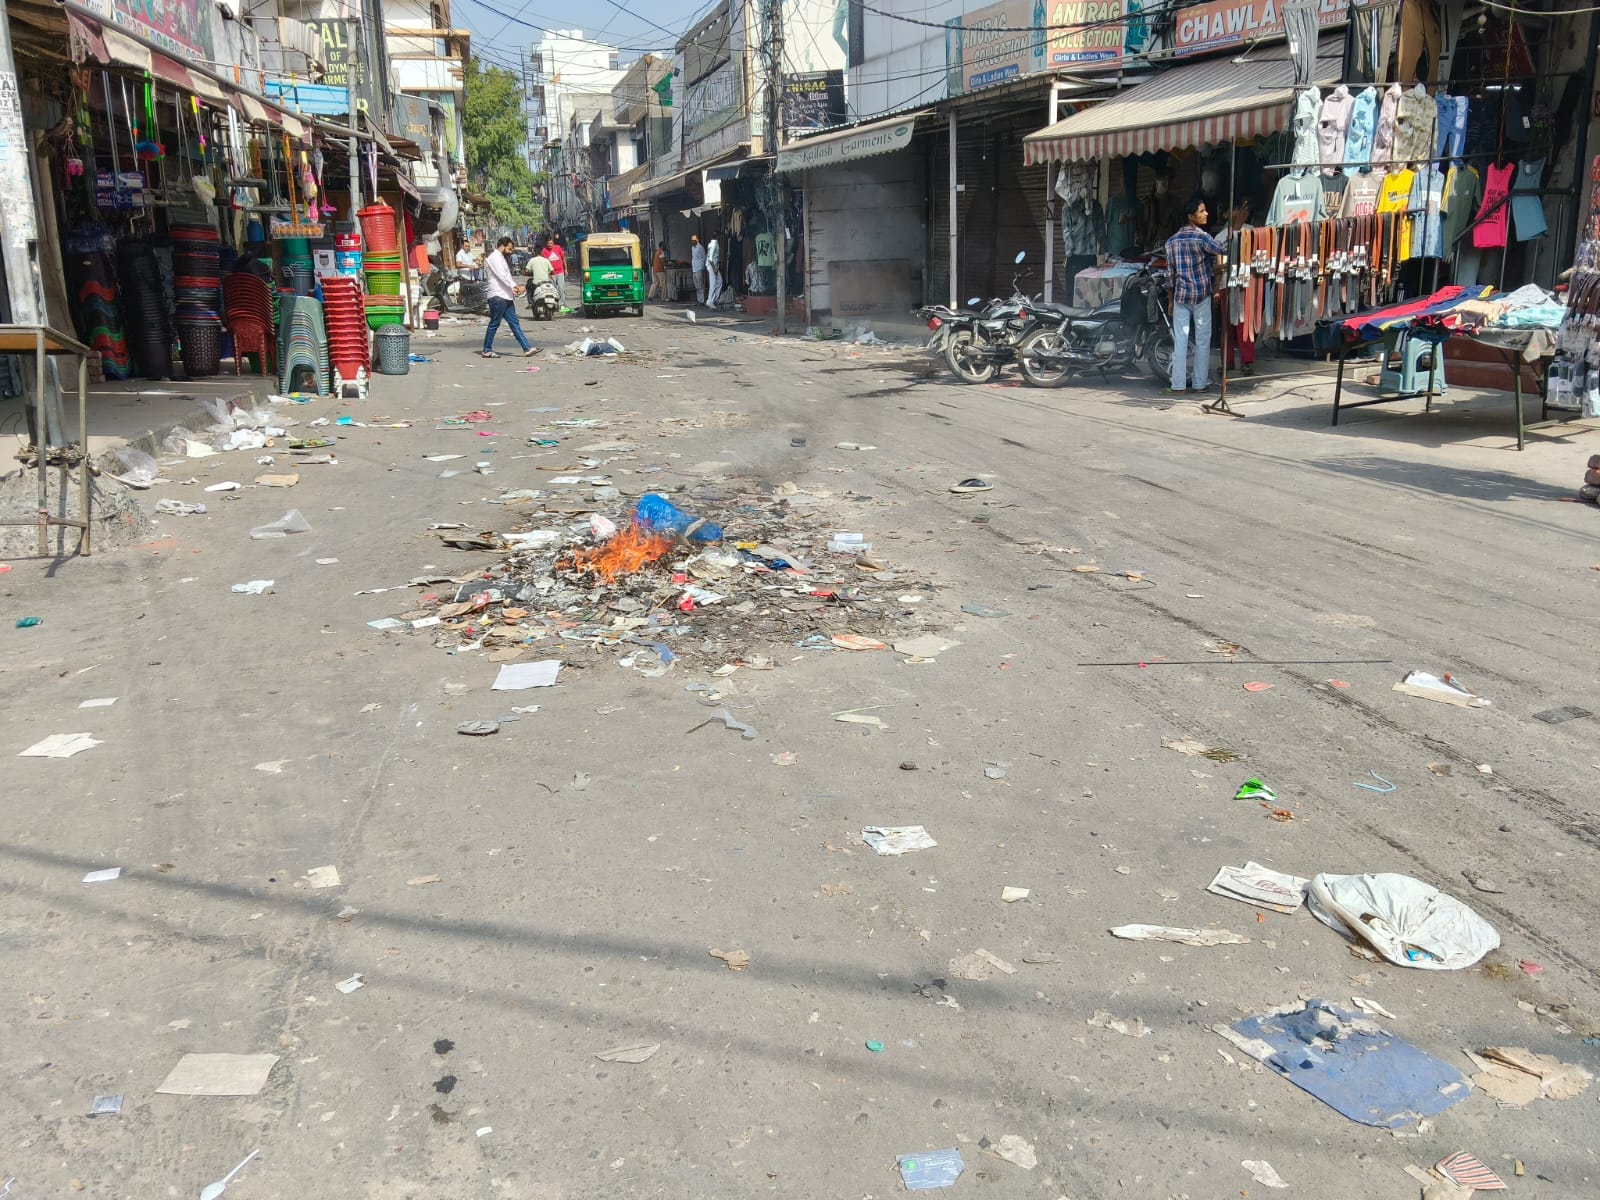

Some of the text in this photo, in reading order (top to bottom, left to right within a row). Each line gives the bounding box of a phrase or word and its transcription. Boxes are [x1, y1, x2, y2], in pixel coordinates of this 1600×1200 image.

[1052, 1, 1120, 25] ANURAG
[1180, 0, 1278, 43] CHAWLA
[961, 12, 1008, 49] ANURAG
[1051, 29, 1121, 49] COLLECTION
[330, 51, 341, 61] OF
[973, 34, 1029, 70] COLLECTION
[1054, 53, 1070, 61] Girls
[840, 131, 893, 155] Garments
